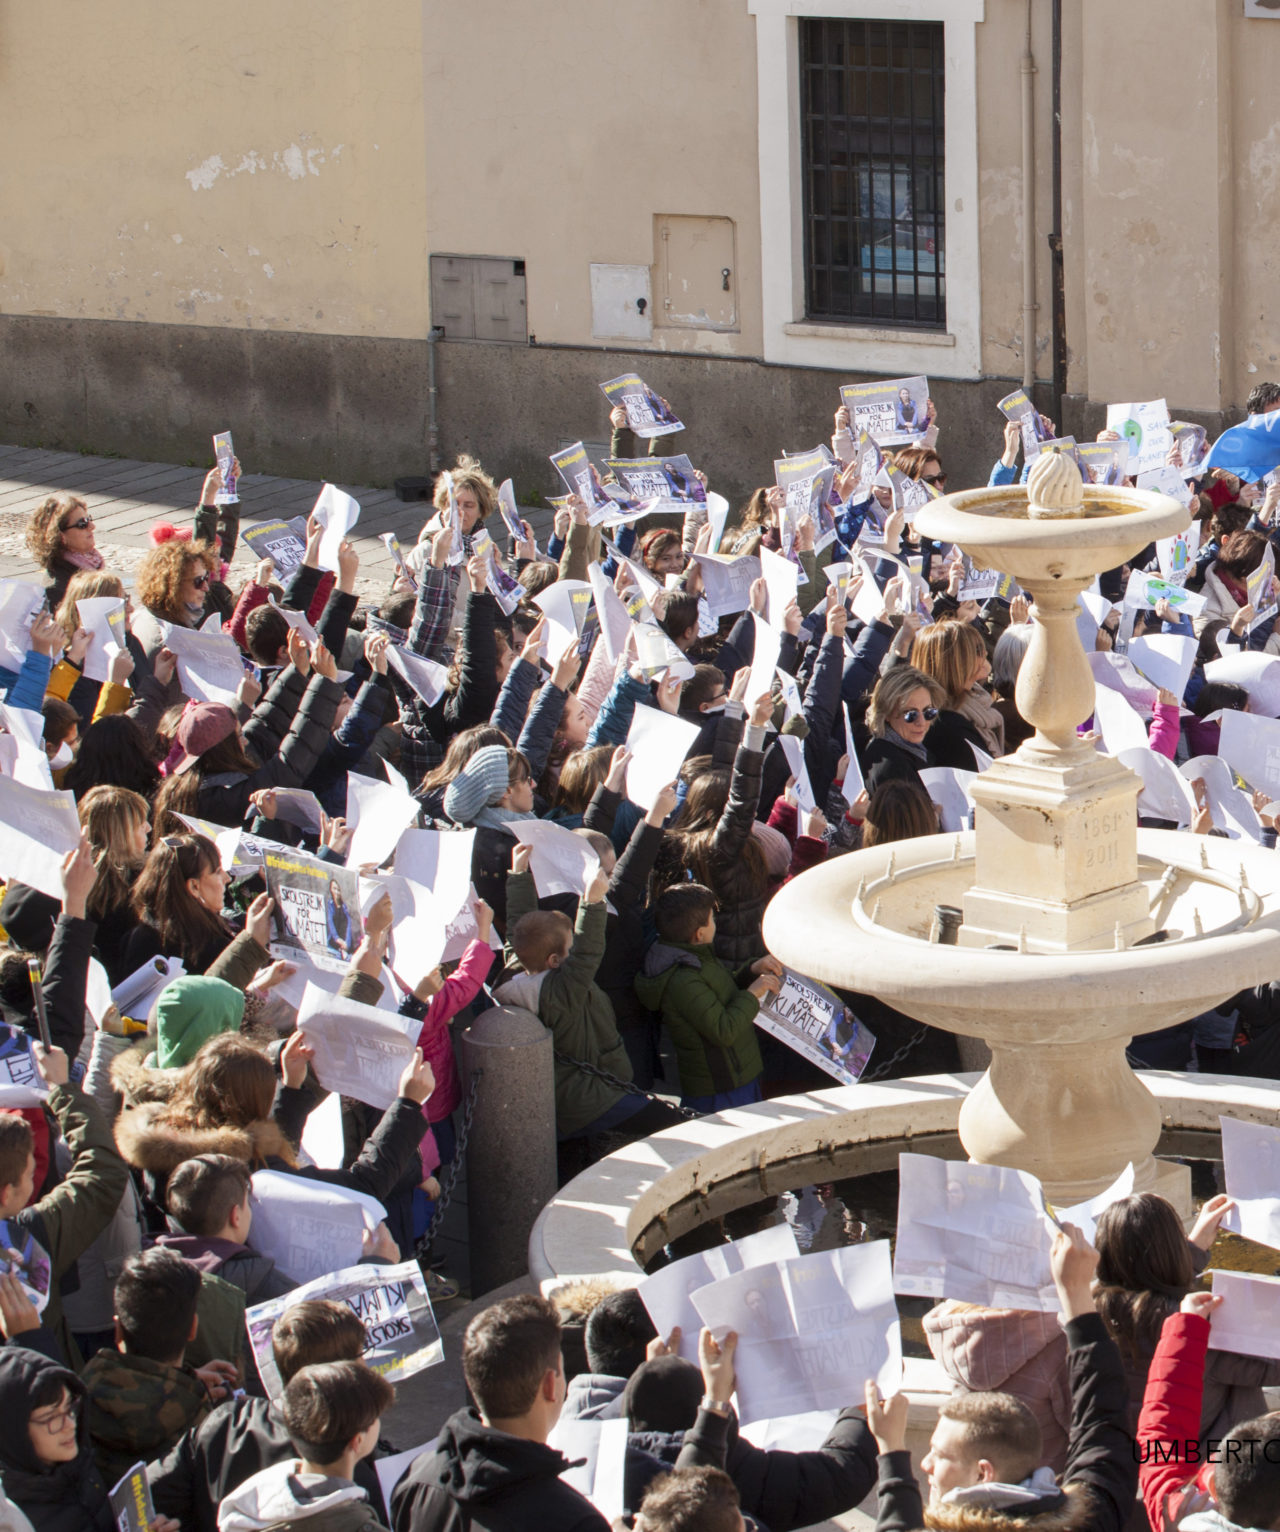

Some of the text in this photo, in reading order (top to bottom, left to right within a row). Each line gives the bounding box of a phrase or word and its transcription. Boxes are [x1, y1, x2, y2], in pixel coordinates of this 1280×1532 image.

[1084, 811, 1119, 840] 1861
[1086, 840, 1118, 868] 2011
[786, 977, 832, 1015] SKOLSTREJK
[769, 995, 827, 1039] KLIMATET
[350, 1281, 405, 1319] KLIMA
